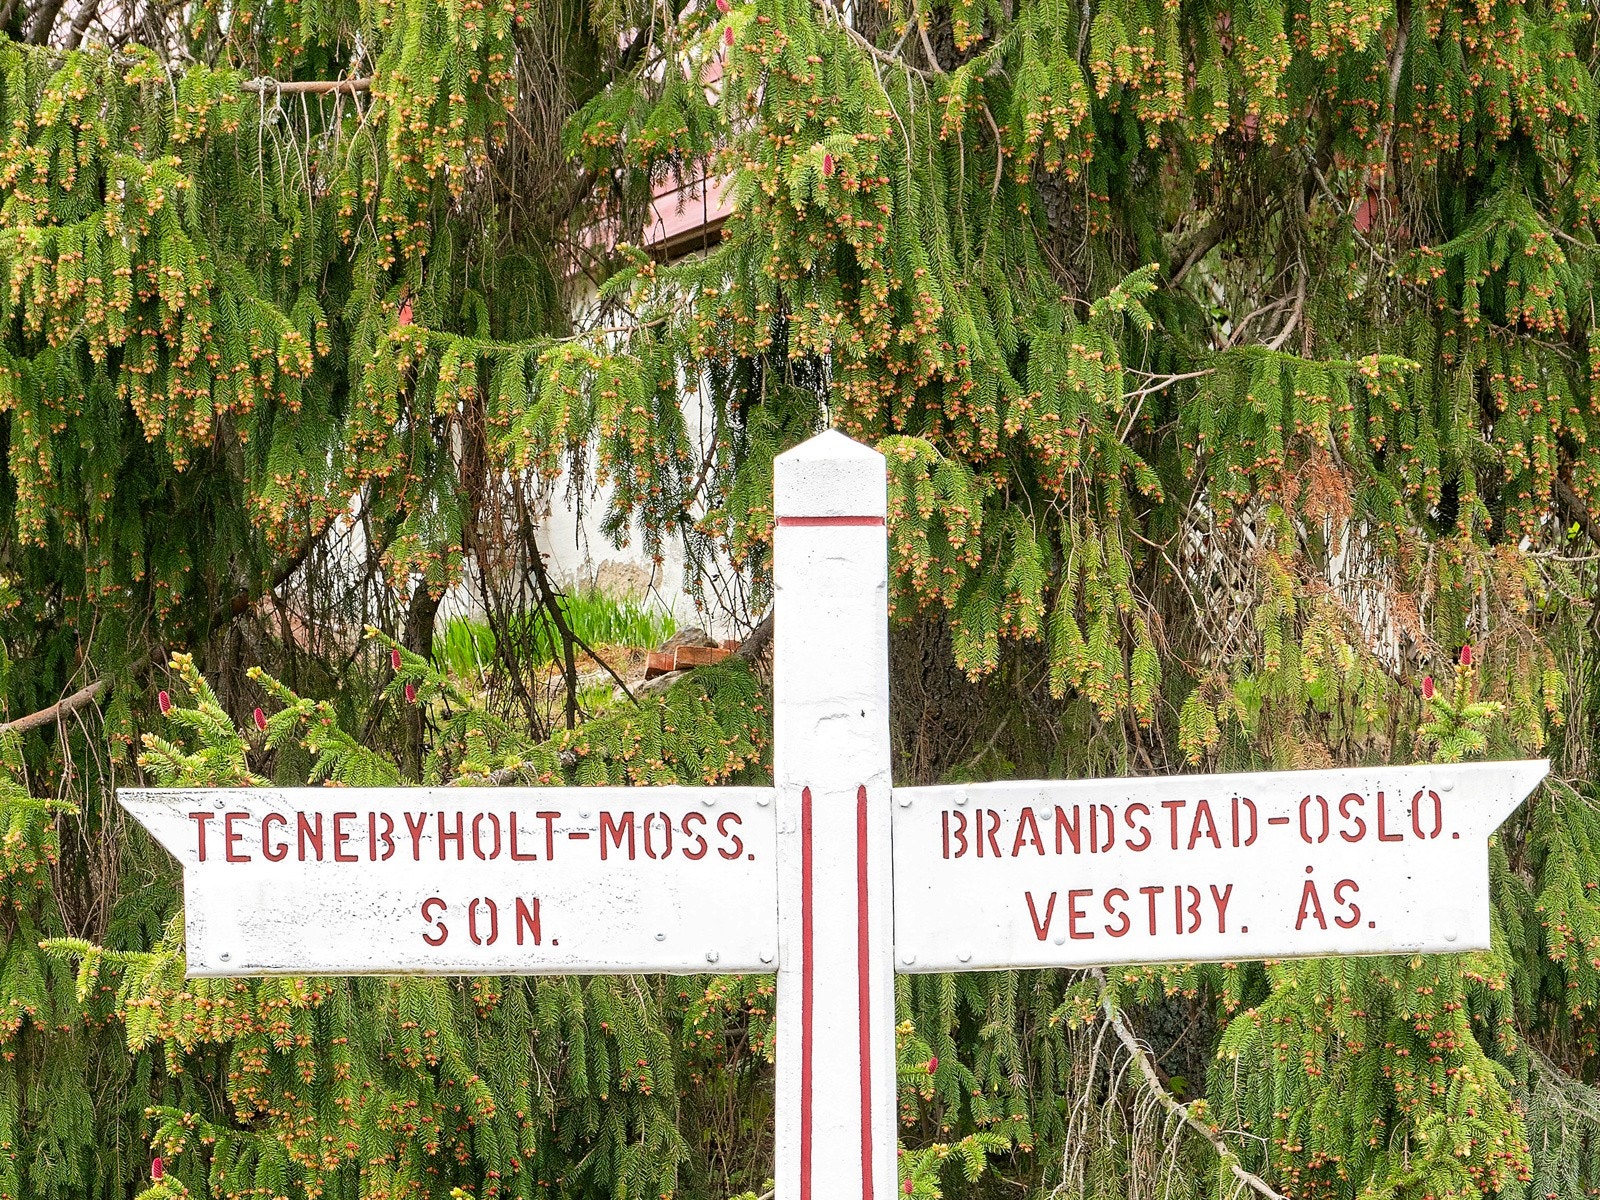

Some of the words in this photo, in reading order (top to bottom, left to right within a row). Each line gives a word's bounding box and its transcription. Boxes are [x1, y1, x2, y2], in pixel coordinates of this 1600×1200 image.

[188, 810, 756, 863] TEGNEBYHOLT-MOSS.
[941, 790, 1461, 860] BRANDSTAD-OSLO.
[421, 896, 559, 947] SON.
[1024, 884, 1249, 942] VESTBY.
[1294, 865, 1376, 931] ÅS.
